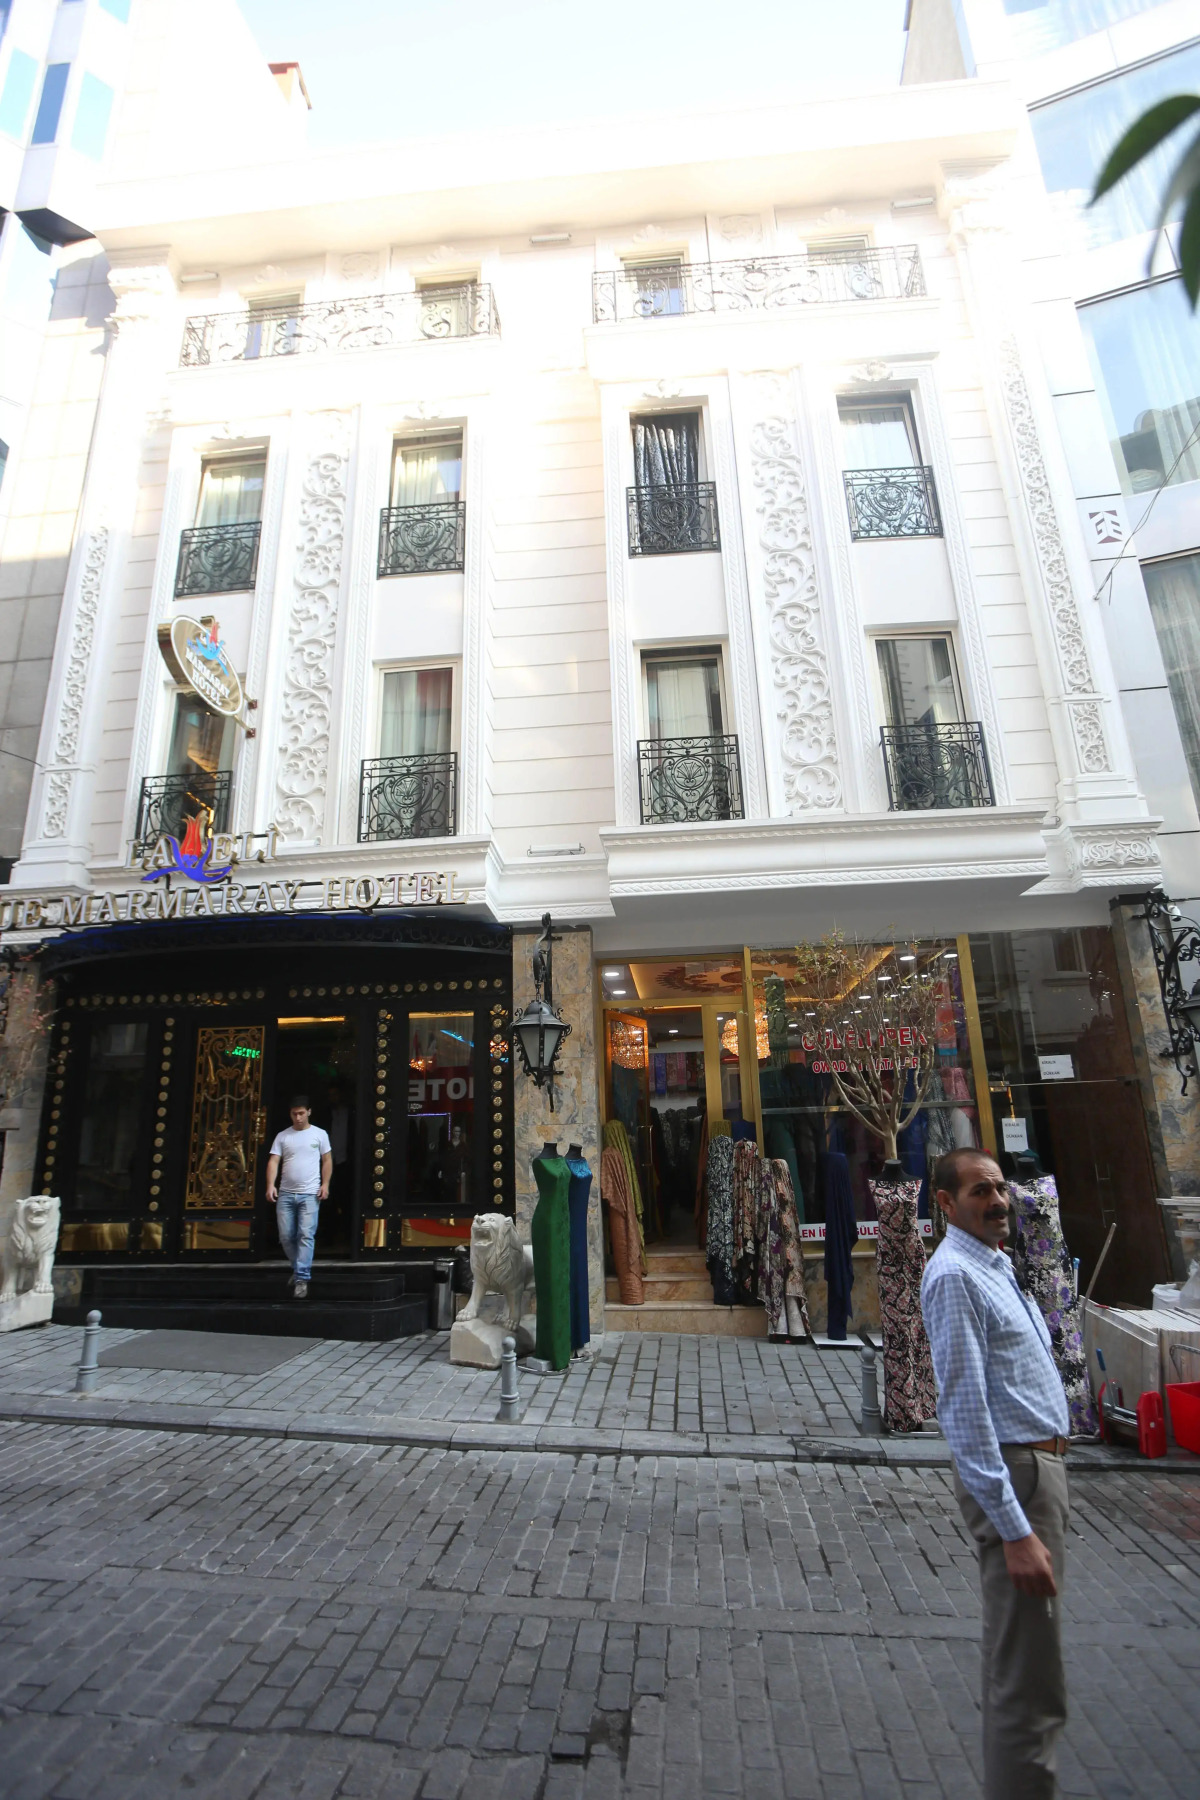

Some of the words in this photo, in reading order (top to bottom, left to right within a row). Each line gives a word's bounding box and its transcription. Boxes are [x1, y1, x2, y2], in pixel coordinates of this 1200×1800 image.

[186, 646, 230, 698] MARMARAY
[192, 668, 222, 705] HOTEL
[58, 879, 304, 926] MARMARAY
[321, 871, 470, 911] HOTEL
